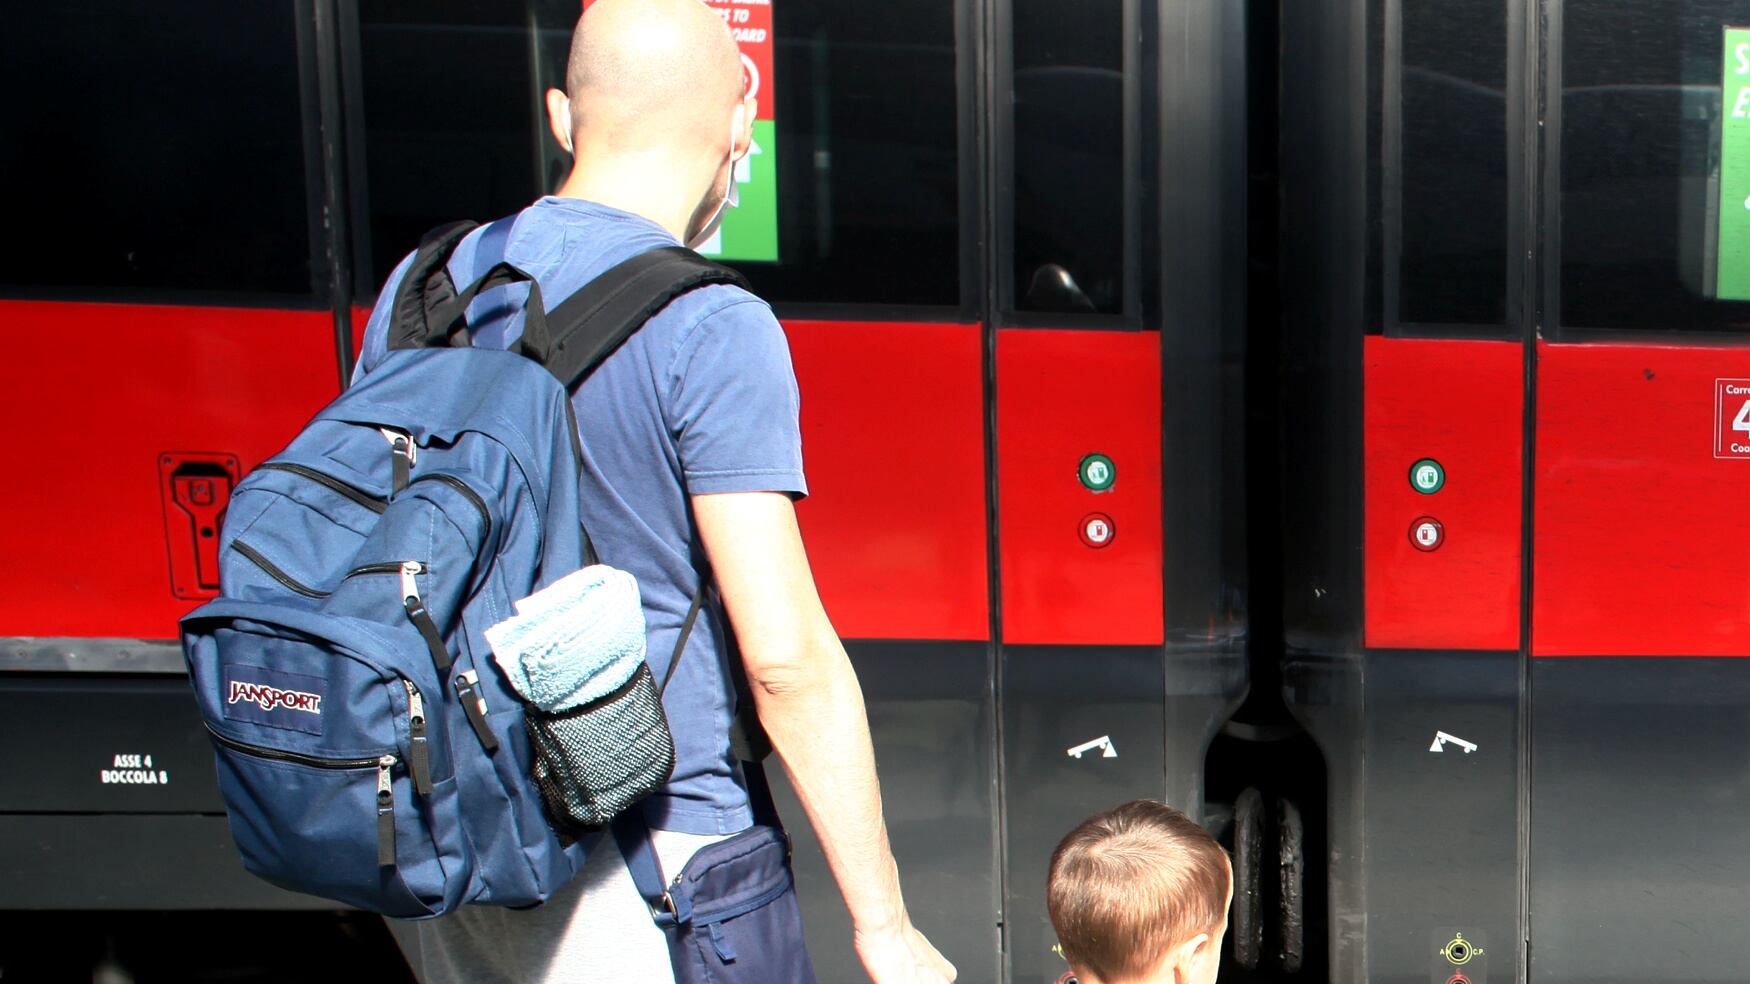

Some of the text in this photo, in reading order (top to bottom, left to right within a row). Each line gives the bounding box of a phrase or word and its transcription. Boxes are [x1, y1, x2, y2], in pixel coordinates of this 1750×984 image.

[731, 27, 767, 43] OARD
[228, 679, 321, 714] JANSPORT
[114, 754, 152, 768] ASSE 4
[101, 769, 168, 784] BOCCOLA 8
